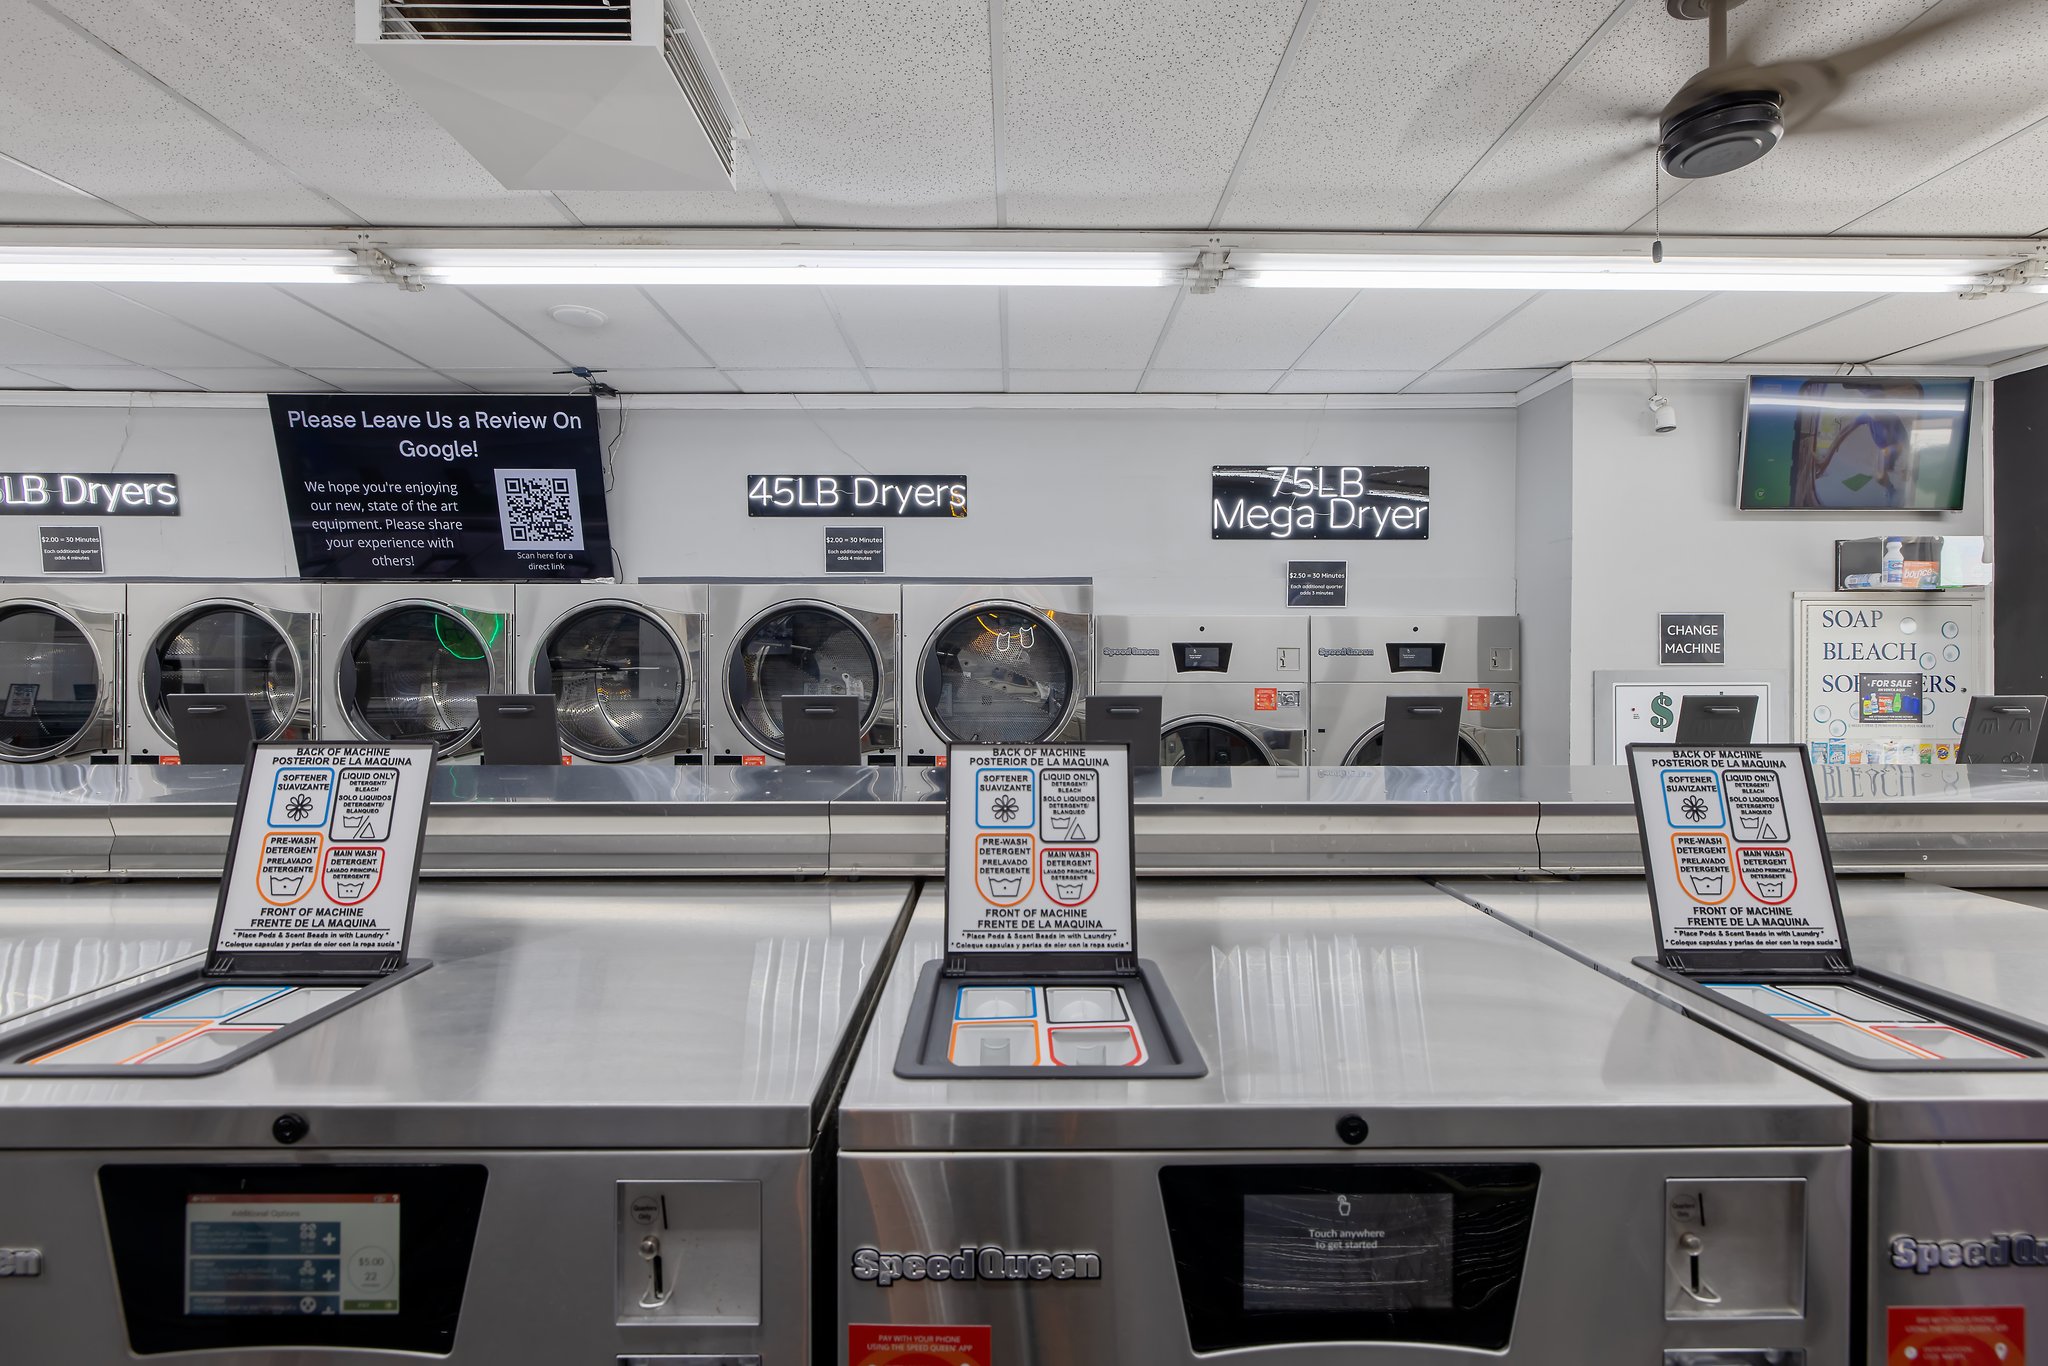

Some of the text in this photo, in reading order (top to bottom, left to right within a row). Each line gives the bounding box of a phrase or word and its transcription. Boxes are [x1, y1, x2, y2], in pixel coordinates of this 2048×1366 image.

[288, 410, 581, 428] Please Leave Us a Review On
[399, 441, 479, 461] Google!
[1268, 467, 1364, 497] 75LB
[61, 475, 178, 512] Dryers
[305, 482, 458, 495] We hope you're enjoying
[750, 477, 967, 513] 45LB Dryers
[311, 501, 459, 512] our new, state of the art
[1213, 499, 1427, 537] Mega Dryer
[312, 520, 462, 532] equipment. Please share
[326, 538, 454, 551] your experience with
[372, 556, 415, 566] others!
[1823, 610, 1883, 628] SOAP
[1668, 625, 1718, 635] CHANGE
[1665, 644, 1720, 653] MACHINE
[1823, 643, 1917, 661] BLEACH
[297, 748, 390, 756] BACK OF MACHINE
[365, 758, 412, 766] MAQUINA
[970, 758, 1109, 766] POSTERIOR DE LA MAQUINA
[1652, 759, 1708, 767] POSTERIOR
[1742, 760, 1786, 768] MAQUINA
[986, 909, 1087, 917] FRONT OF MACHINE
[978, 920, 1018, 928] FRENTE
[1022, 920, 1034, 928] DE
[1055, 921, 1102, 929] MAQUINA
[1309, 1229, 1385, 1240] Touch anywhere
[1316, 1240, 1378, 1251] to get started
[1889, 1233, 2010, 1275] Speed
[359, 1258, 384, 1267] $5.00
[852, 1246, 1102, 1287] Speed Queen
[914, 1335, 933, 1343] YOUR
[906, 1344, 929, 1352] SPEED
